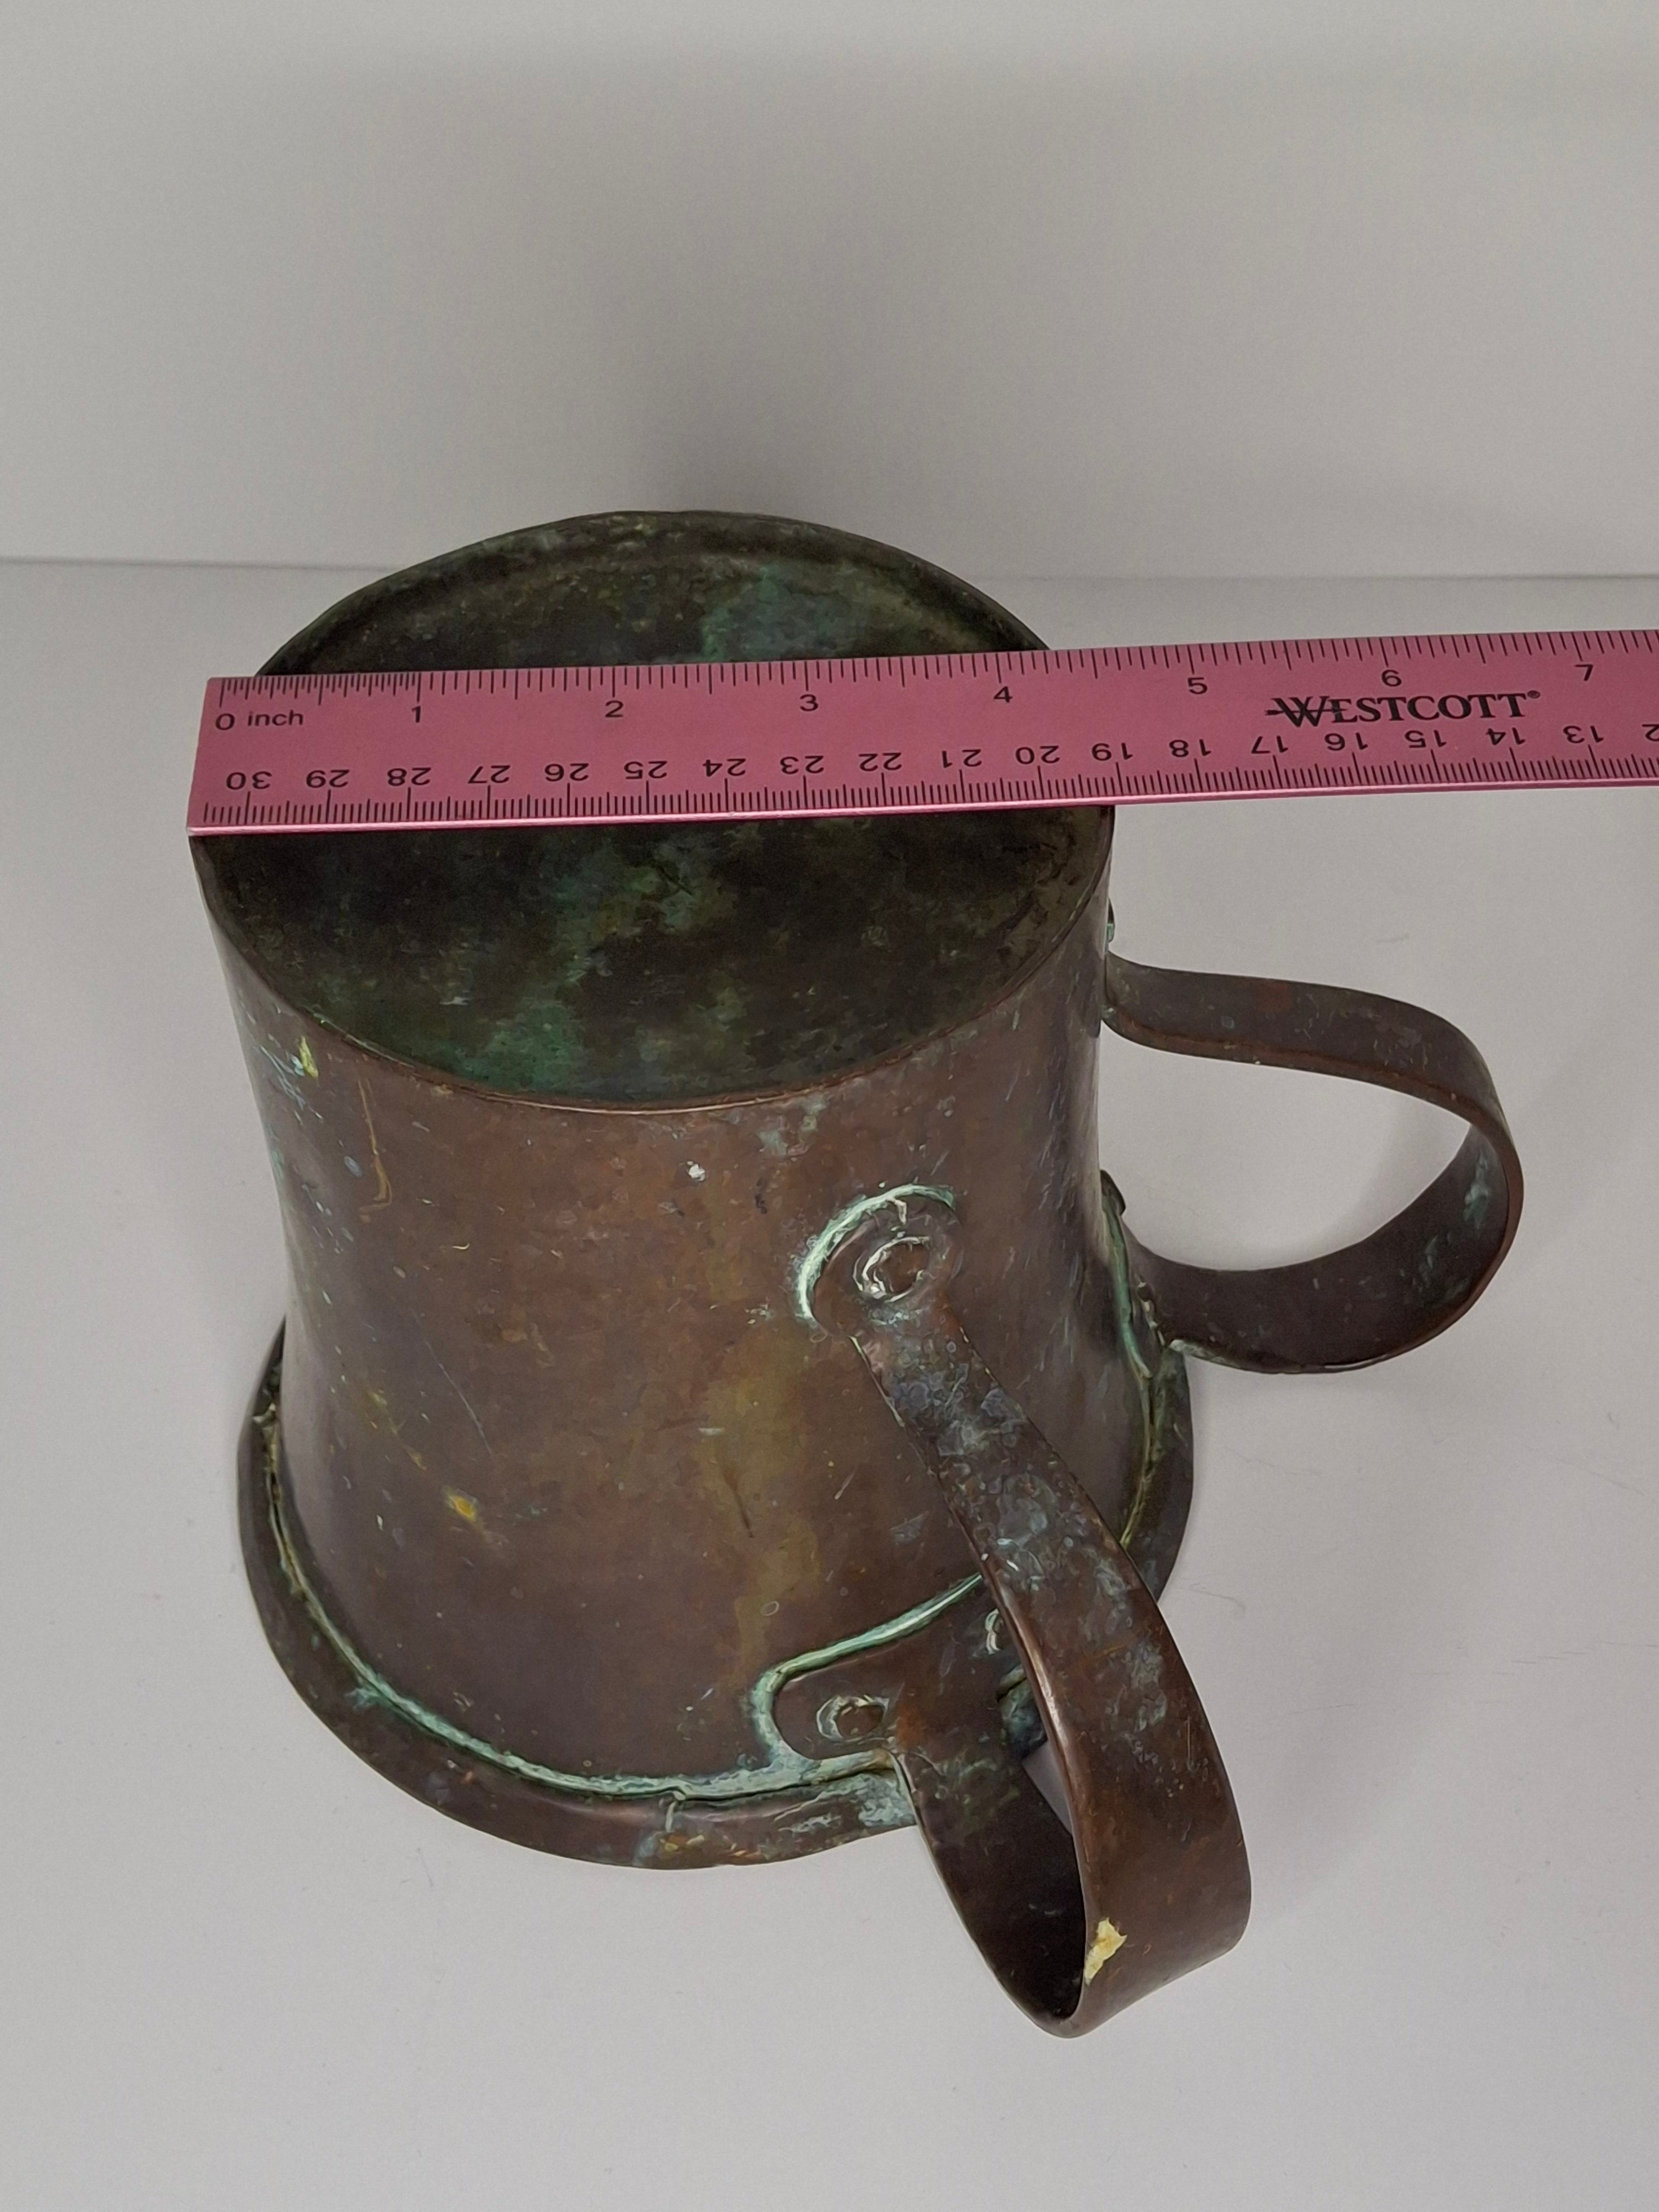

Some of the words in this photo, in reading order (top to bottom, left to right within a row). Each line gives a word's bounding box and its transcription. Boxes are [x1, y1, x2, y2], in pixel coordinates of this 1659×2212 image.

[215, 713, 235, 731] 0
[247, 710, 304, 726] inch
[411, 705, 421, 723] 1
[605, 700, 624, 718] 2
[800, 694, 819, 712] 3
[993, 686, 1013, 703] 4
[1187, 677, 1208, 695] 5
[1381, 669, 1402, 687] 6
[1575, 664, 1593, 681] 7
[1324, 732, 1368, 751] 16
[1404, 730, 1447, 748] 15
[1486, 727, 1526, 746] 14
[1562, 725, 1604, 744] 13
[1091, 742, 1133, 761] 19
[1169, 738, 1212, 758] 18
[1251, 735, 1289, 754] 17
[858, 752, 902, 772] 22
[942, 749, 982, 769] 21
[1015, 745, 1060, 765] 20
[467, 764, 511, 784] 27
[544, 763, 589, 782] 26
[623, 760, 668, 780] 25
[702, 758, 746, 777] 24
[780, 755, 824, 775] 23
[226, 771, 272, 790] 30
[306, 769, 350, 788] 29
[387, 767, 432, 787] 28
